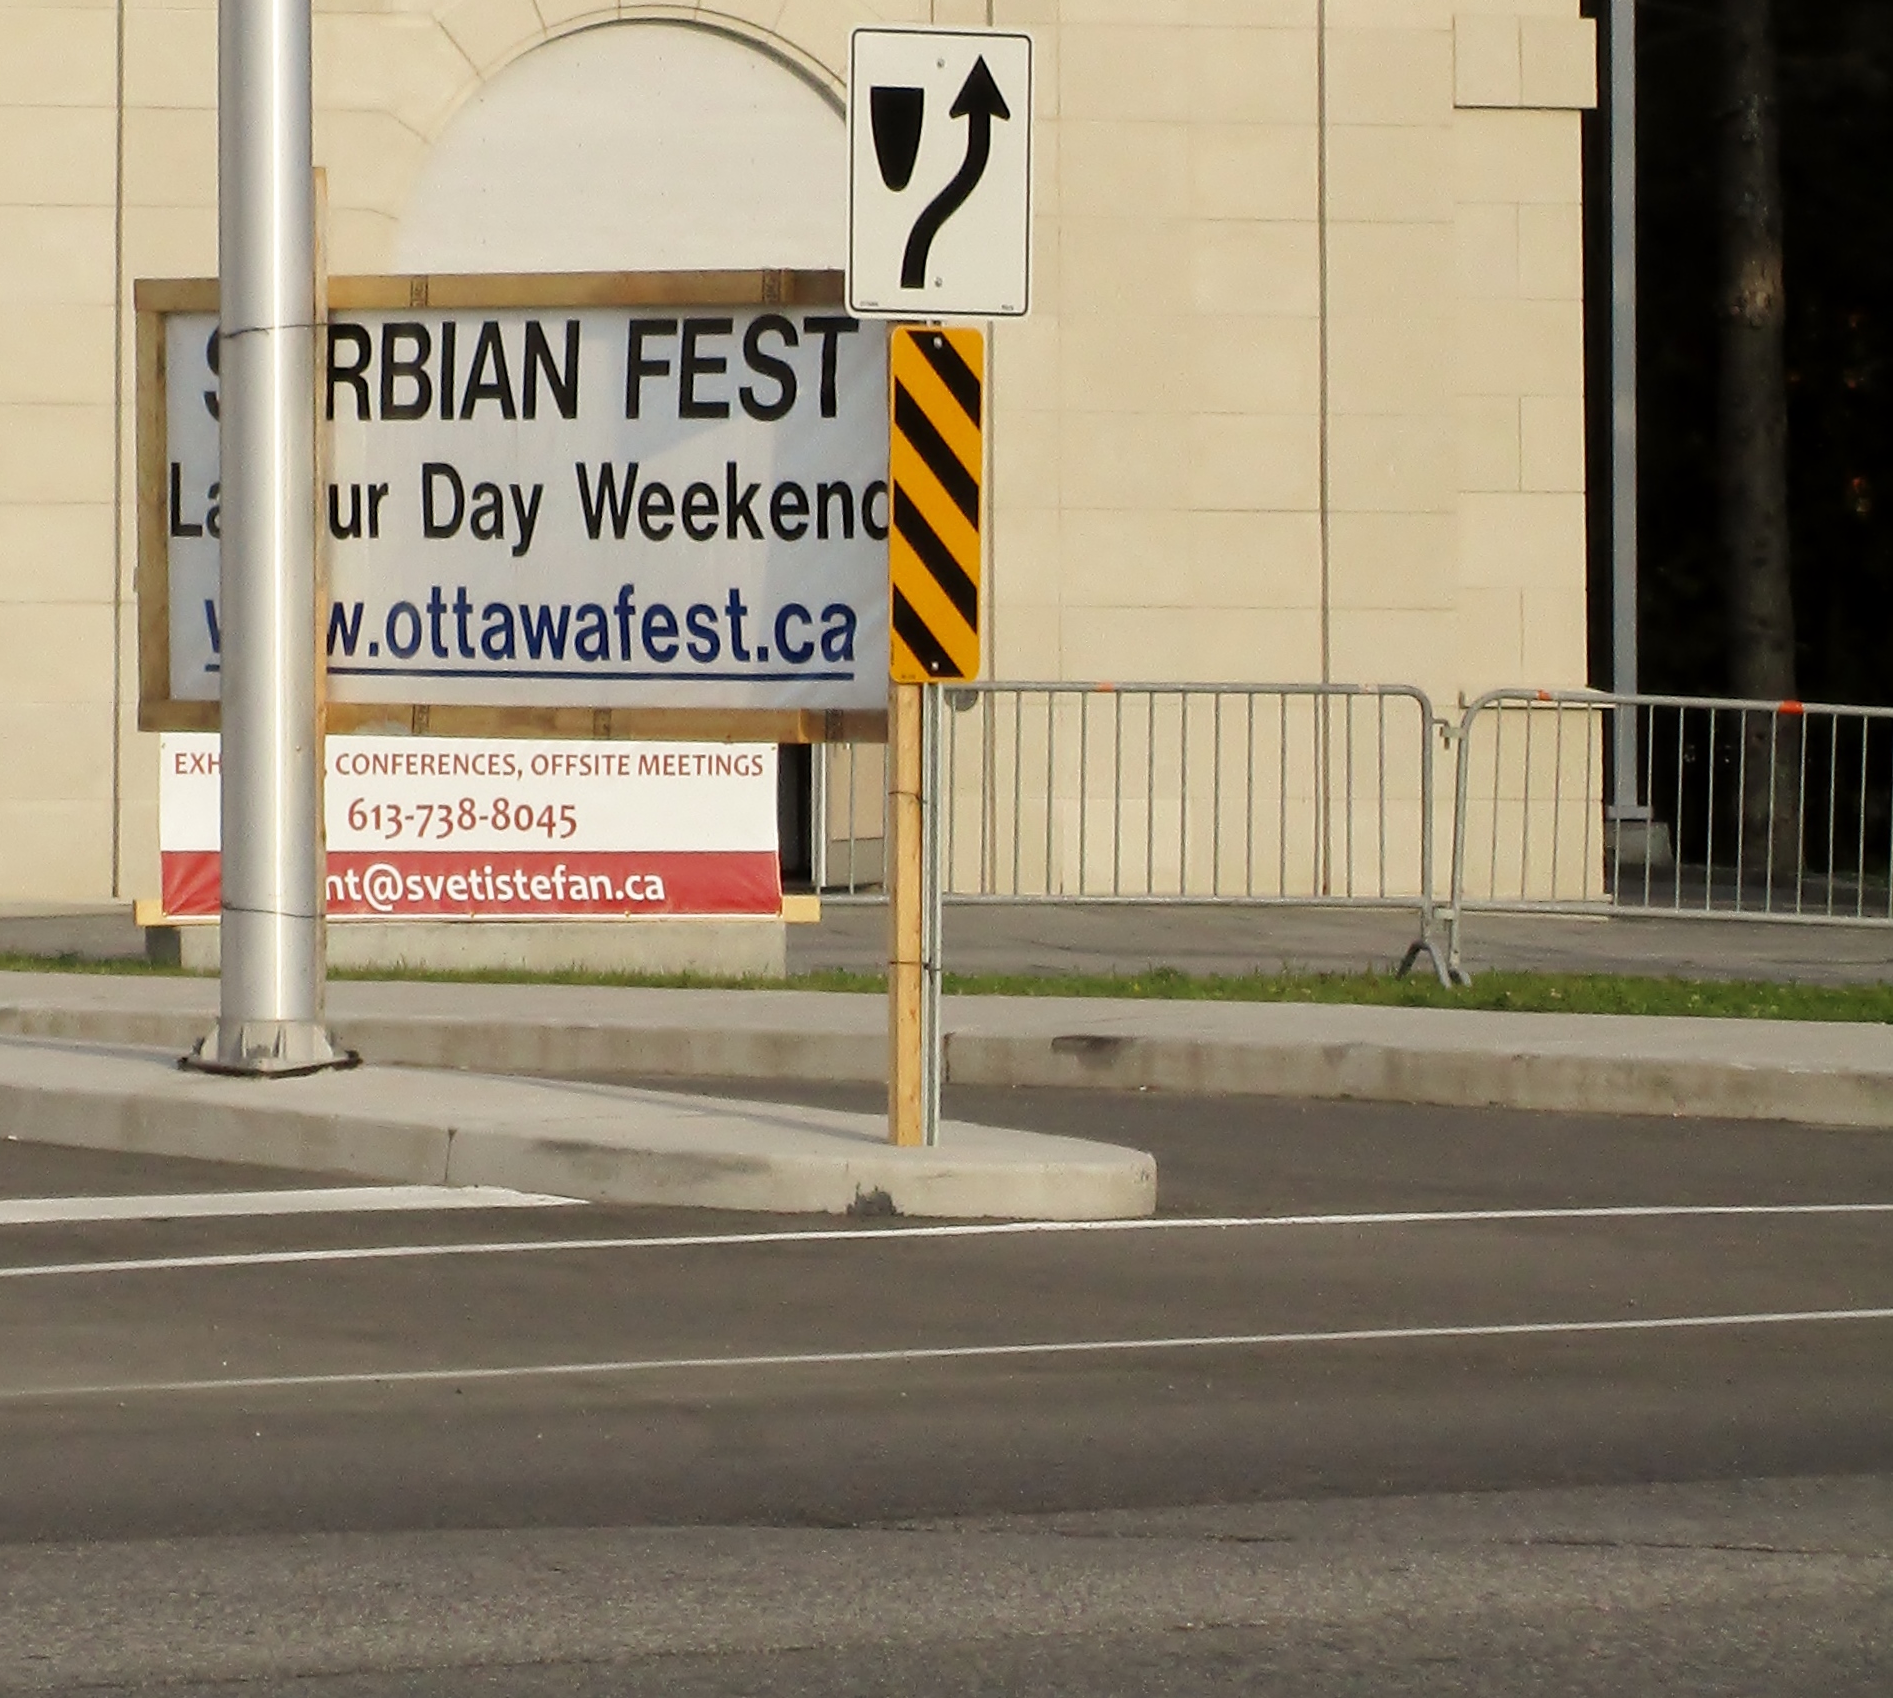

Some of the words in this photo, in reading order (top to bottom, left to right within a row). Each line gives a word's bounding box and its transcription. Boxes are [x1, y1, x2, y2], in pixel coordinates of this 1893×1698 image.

[204, 319, 580, 423] RBIAN
[626, 313, 860, 422] FEST
[170, 461, 389, 540] Lur
[422, 461, 544, 557] Day
[204, 583, 857, 665] w.ottawafest.ca
[335, 752, 524, 781] CONFERENCES,
[530, 753, 631, 777] OFFSITE
[637, 753, 765, 777] MEETINGS
[347, 796, 578, 840] 613-738-8045
[325, 863, 666, 913] nt@svetistefan.ca
